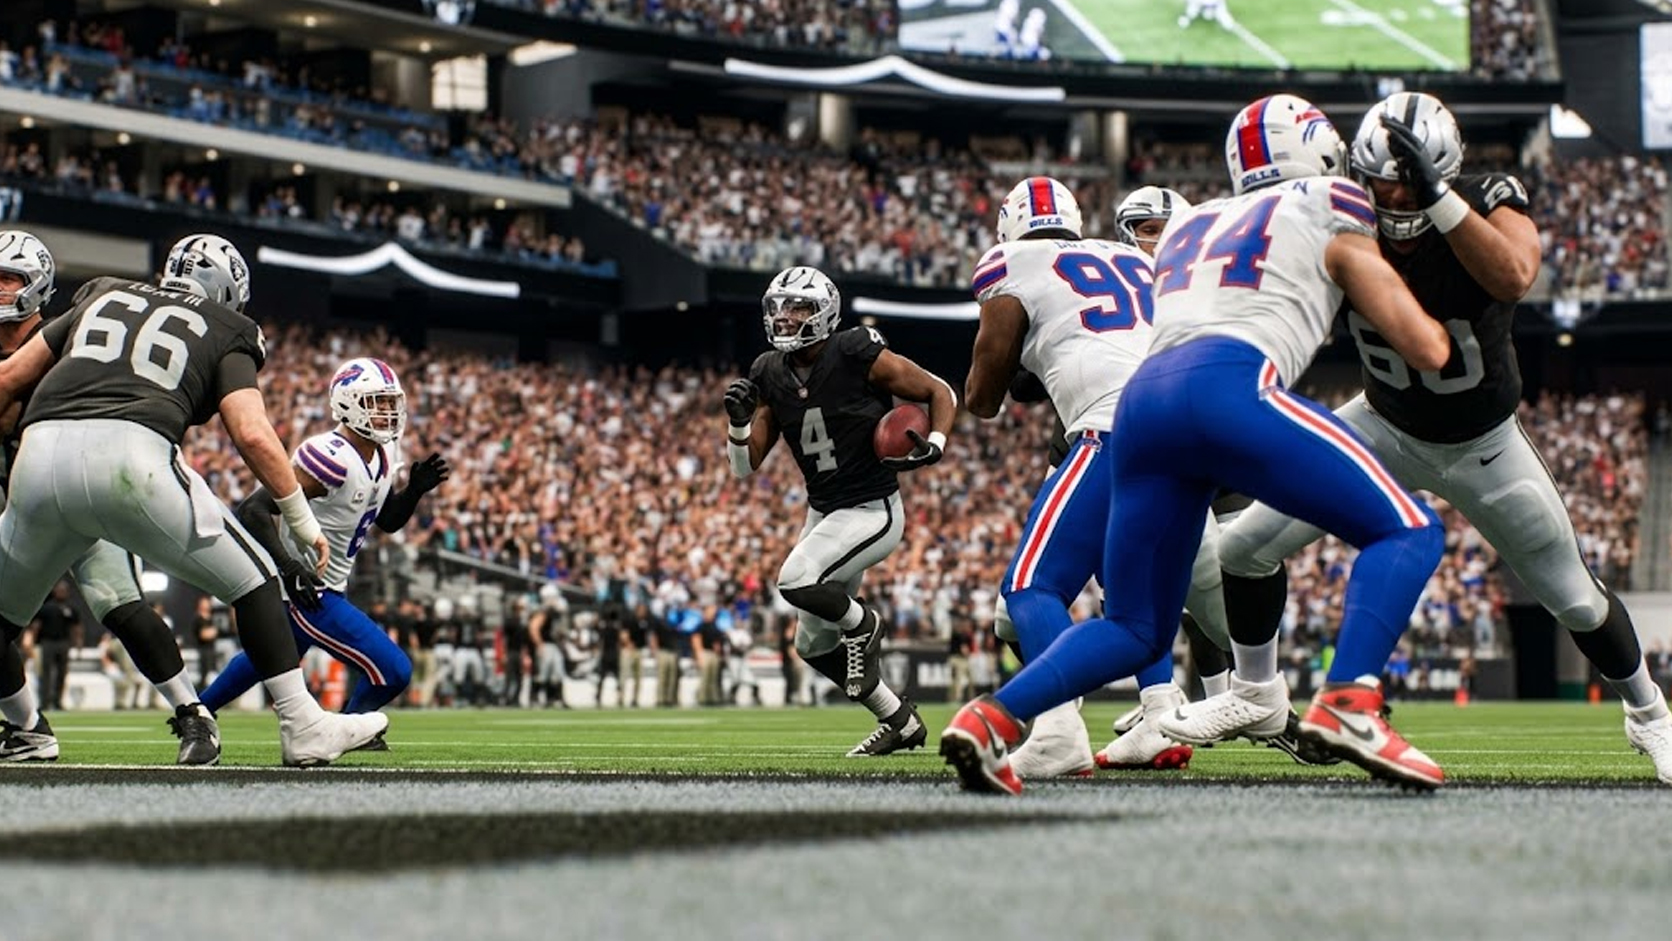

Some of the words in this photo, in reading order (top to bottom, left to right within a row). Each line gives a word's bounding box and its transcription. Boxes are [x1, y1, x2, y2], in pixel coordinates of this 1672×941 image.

[1155, 195, 1282, 297] 44
[70, 289, 209, 391] 66
[1348, 310, 1485, 395] 60
[800, 407, 838, 473] 4
